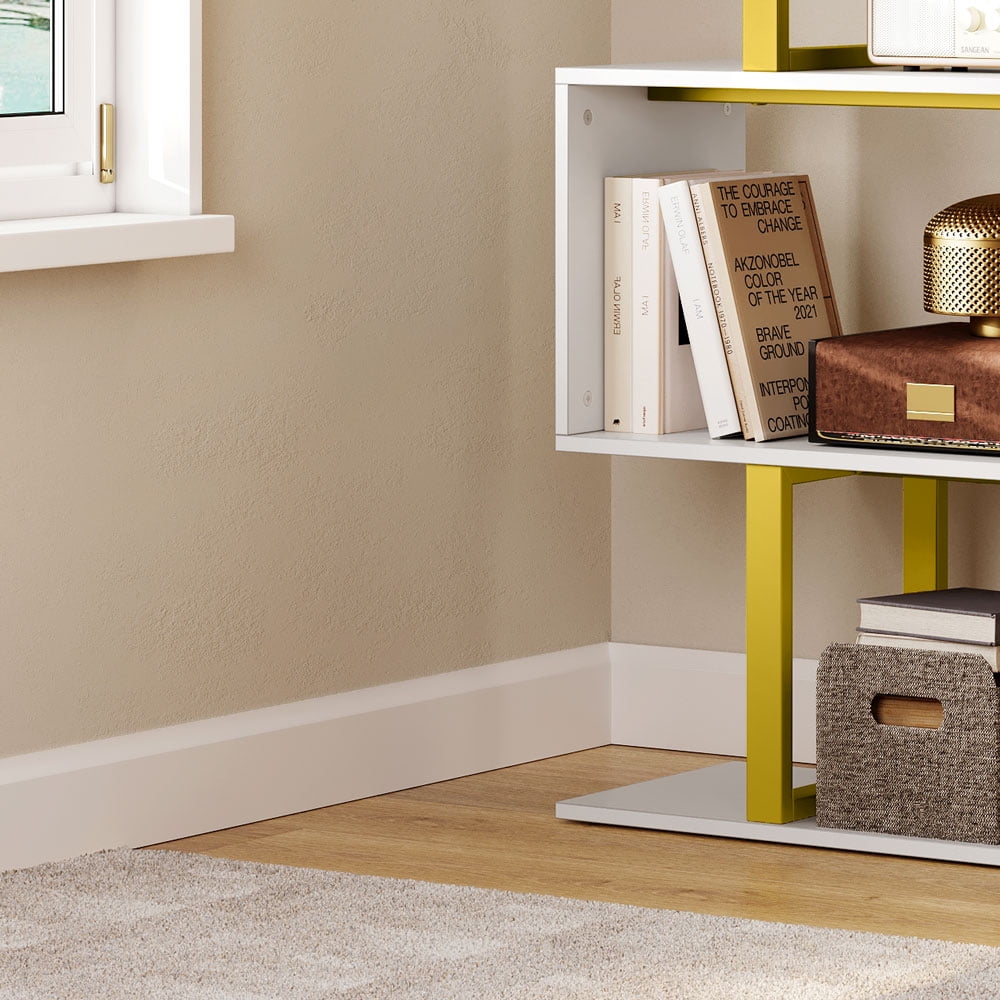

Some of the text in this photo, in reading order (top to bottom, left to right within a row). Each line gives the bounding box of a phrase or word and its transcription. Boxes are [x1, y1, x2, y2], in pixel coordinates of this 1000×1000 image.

[960, 46, 990, 54] SANGEAN
[717, 181, 795, 201] THE COURAGE
[721, 199, 793, 219] TO EMBRACE
[671, 196, 690, 255] ERWIN OLAF
[692, 193, 709, 246] ANNI ALBERS
[757, 216, 803, 234] CHANGE
[734, 252, 799, 272] AKZONOBEL
[707, 262, 722, 307] NOTEBOOK
[744, 271, 783, 289] COLOR
[748, 285, 818, 307] OF THE YEAR
[695, 304, 704, 320] AM
[793, 305, 818, 320] 2021
[755, 324, 792, 343] BRAVE
[759, 341, 805, 361] GROUND
[792, 395, 809, 411] PO
